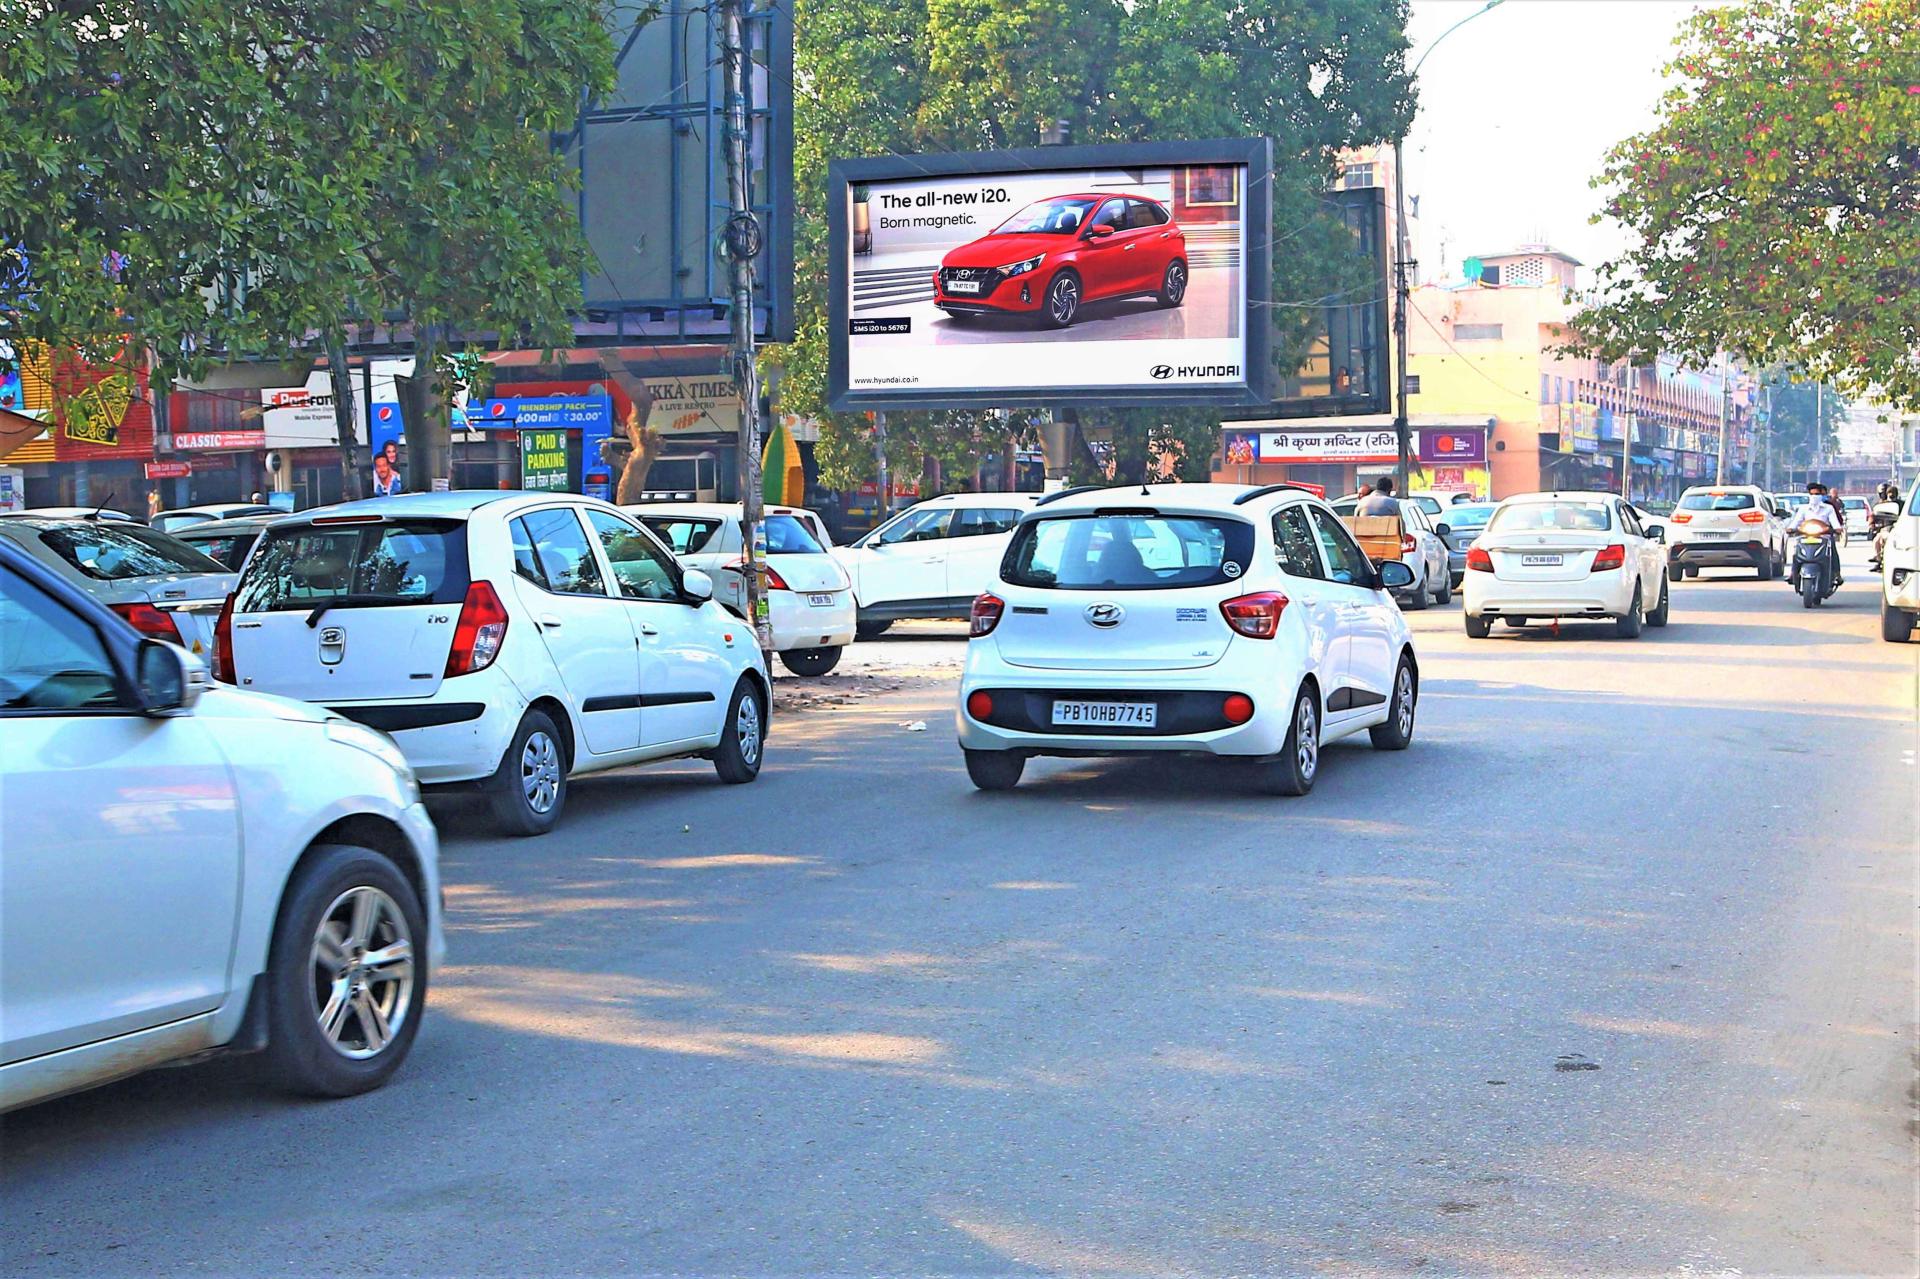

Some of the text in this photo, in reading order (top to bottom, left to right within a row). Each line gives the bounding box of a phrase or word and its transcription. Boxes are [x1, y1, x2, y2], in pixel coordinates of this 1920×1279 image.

[880, 188, 1011, 209] The all-new i20.
[880, 213, 977, 228] Born magnetic.
[869, 324, 879, 332] i20
[1178, 365, 1240, 377] HYUNDAI
[854, 376, 919, 384] www.hyundai.co.in
[648, 381, 736, 400] IKKA TIMES
[518, 404, 562, 412] FRIENDSHIP
[684, 401, 715, 410] RESTRO
[175, 434, 222, 449] CLASSIC
[535, 434, 556, 450] PAID
[1272, 435, 1288, 448] श्री
[1292, 437, 1320, 451] कृष्ण
[1324, 434, 1361, 448] मन्दिर
[527, 452, 566, 470] PARKING
[1063, 704, 1153, 722] PB10HB7745
